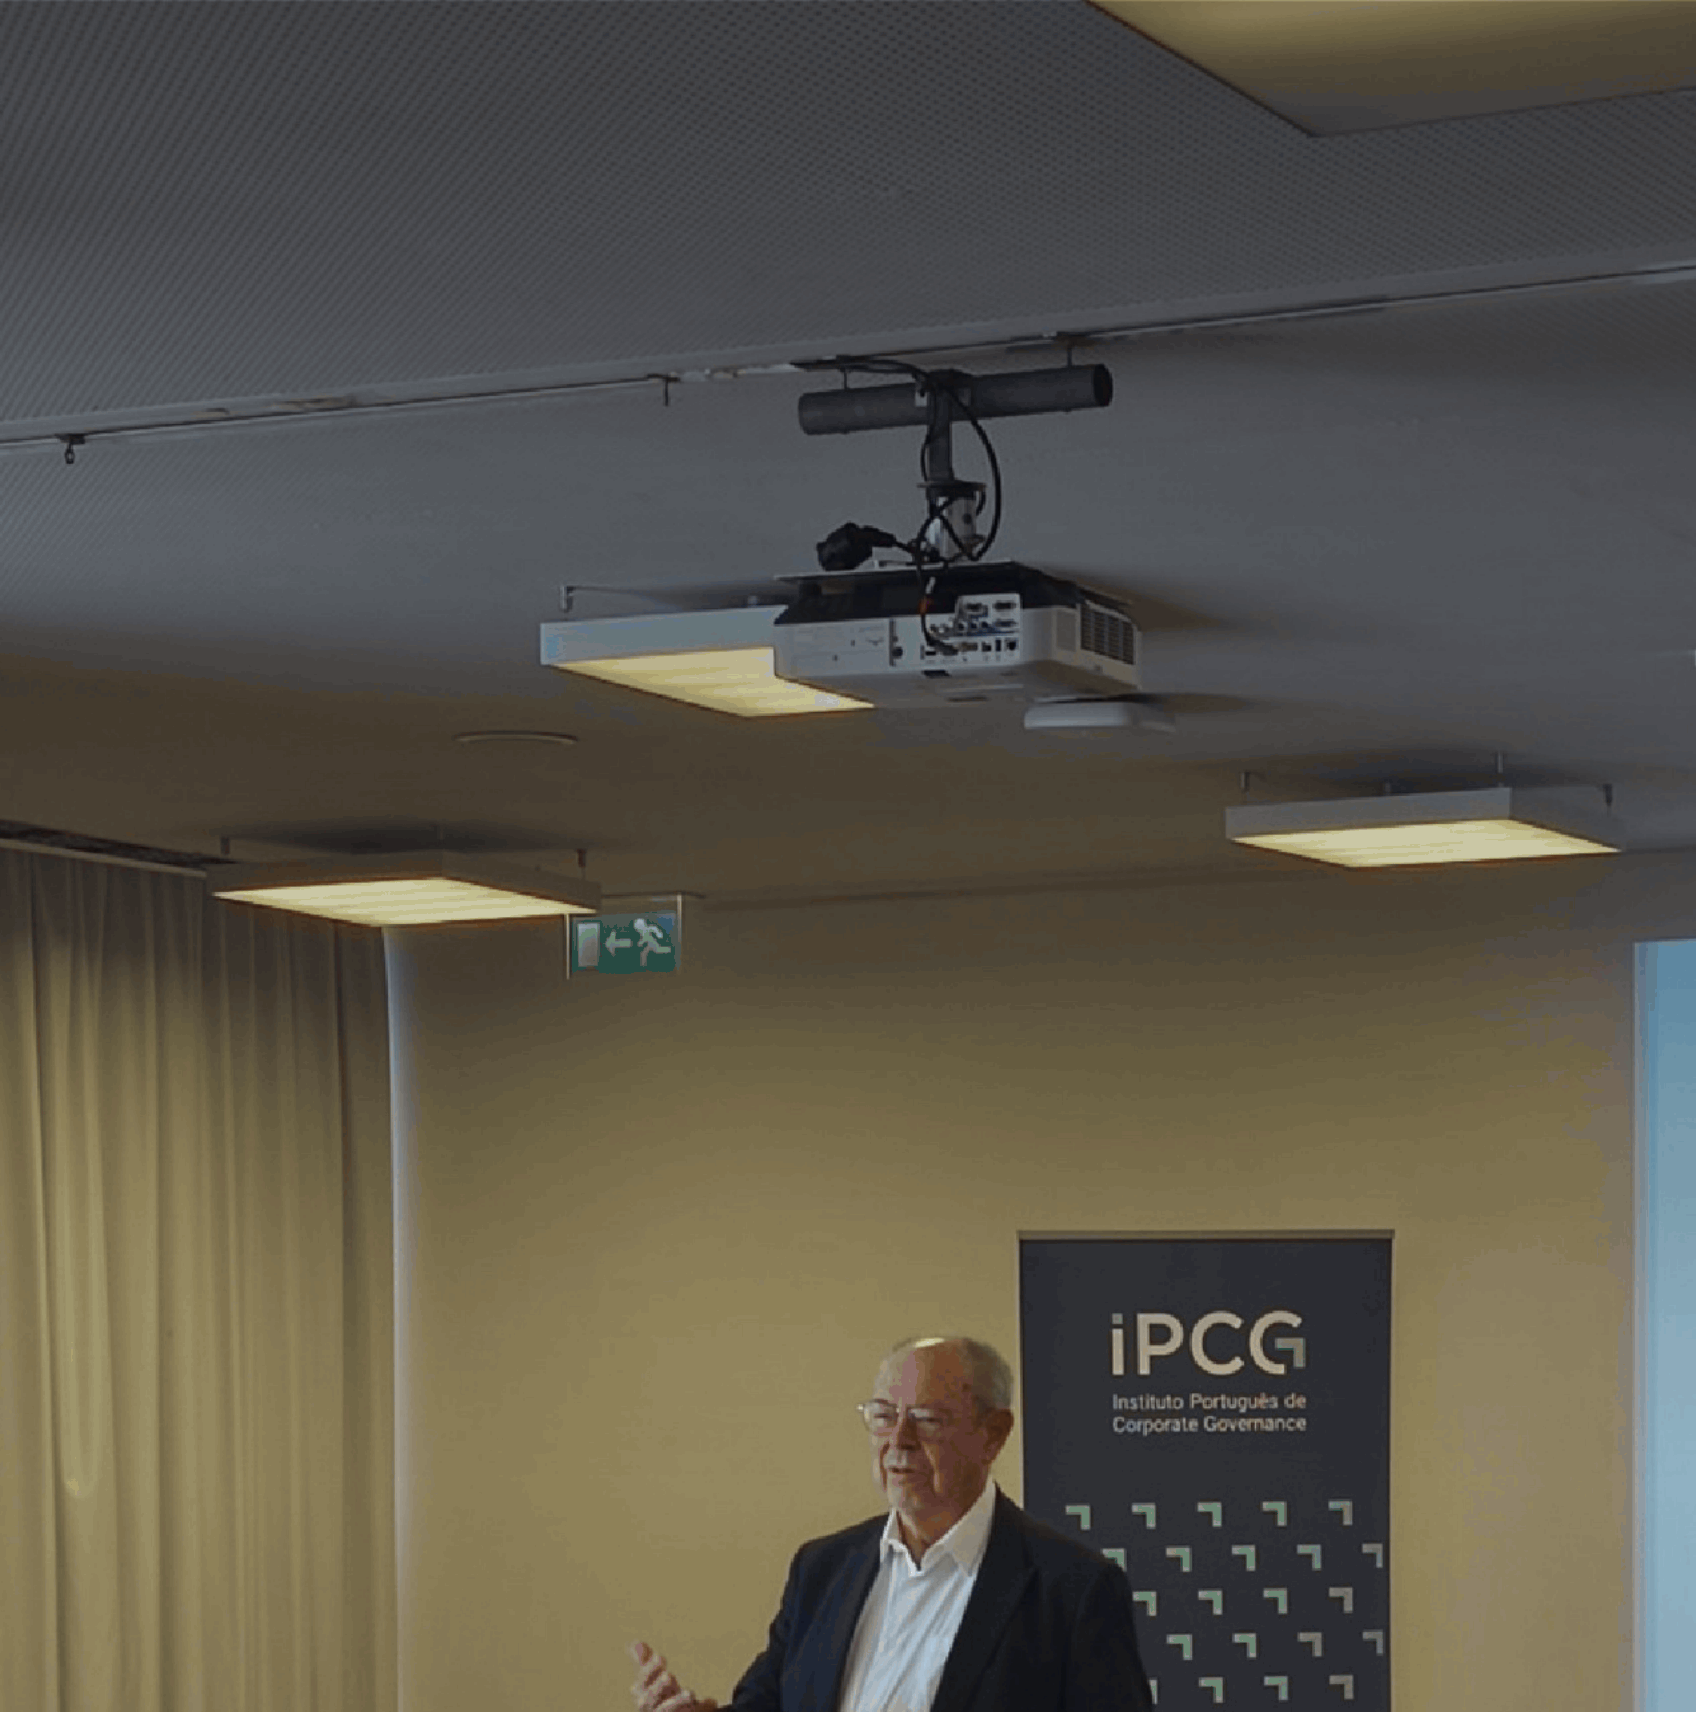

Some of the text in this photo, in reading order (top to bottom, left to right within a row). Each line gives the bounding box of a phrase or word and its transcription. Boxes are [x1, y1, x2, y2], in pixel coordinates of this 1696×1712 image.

[1111, 1392, 1307, 1414] Instituto Português de
[1111, 1416, 1307, 1437] Corporate Governance
